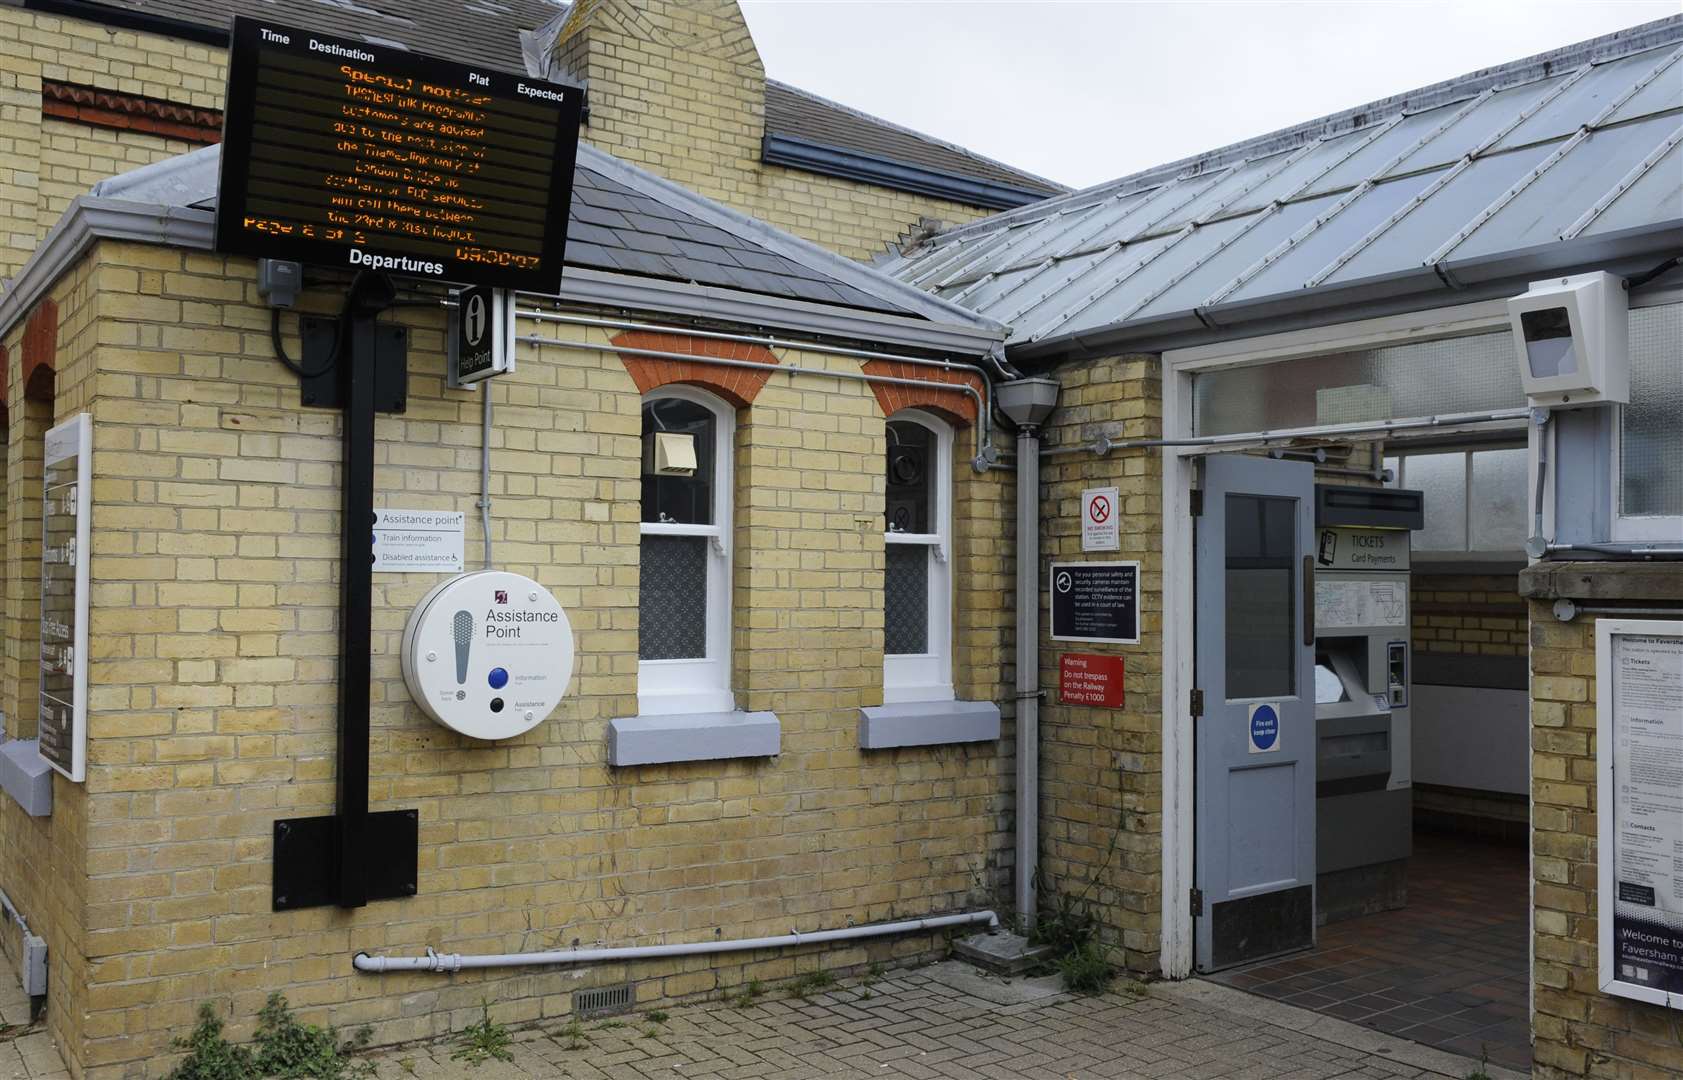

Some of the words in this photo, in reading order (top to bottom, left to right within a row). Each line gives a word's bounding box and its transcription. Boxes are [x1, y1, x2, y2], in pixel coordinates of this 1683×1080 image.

[260, 28, 291, 46] Time
[309, 39, 376, 63] Destination
[469, 72, 490, 87] Plat
[517, 83, 564, 103] Expected
[438, 124, 486, 139] advised
[349, 248, 444, 275] Departures
[383, 514, 432, 524] Assistance
[435, 516, 459, 526] point
[1352, 535, 1384, 548] TICKETS
[1352, 553, 1366, 563] Card
[1367, 554, 1396, 565] Payments
[486, 609, 558, 622] Assistance
[486, 625, 521, 638] Point
[1064, 658, 1087, 668] Warning
[1064, 670, 1072, 678] Do
[1084, 672, 1107, 681] trespass
[1083, 682, 1104, 692] Railway
[1064, 691, 1084, 702] Penalty
[1086, 693, 1104, 701] £1000
[1630, 717, 1664, 725] Information
[1630, 822, 1656, 832] Contacts
[1622, 928, 1670, 946] Welcome
[1672, 939, 1683, 949] to
[1622, 942, 1678, 962] Faversham
